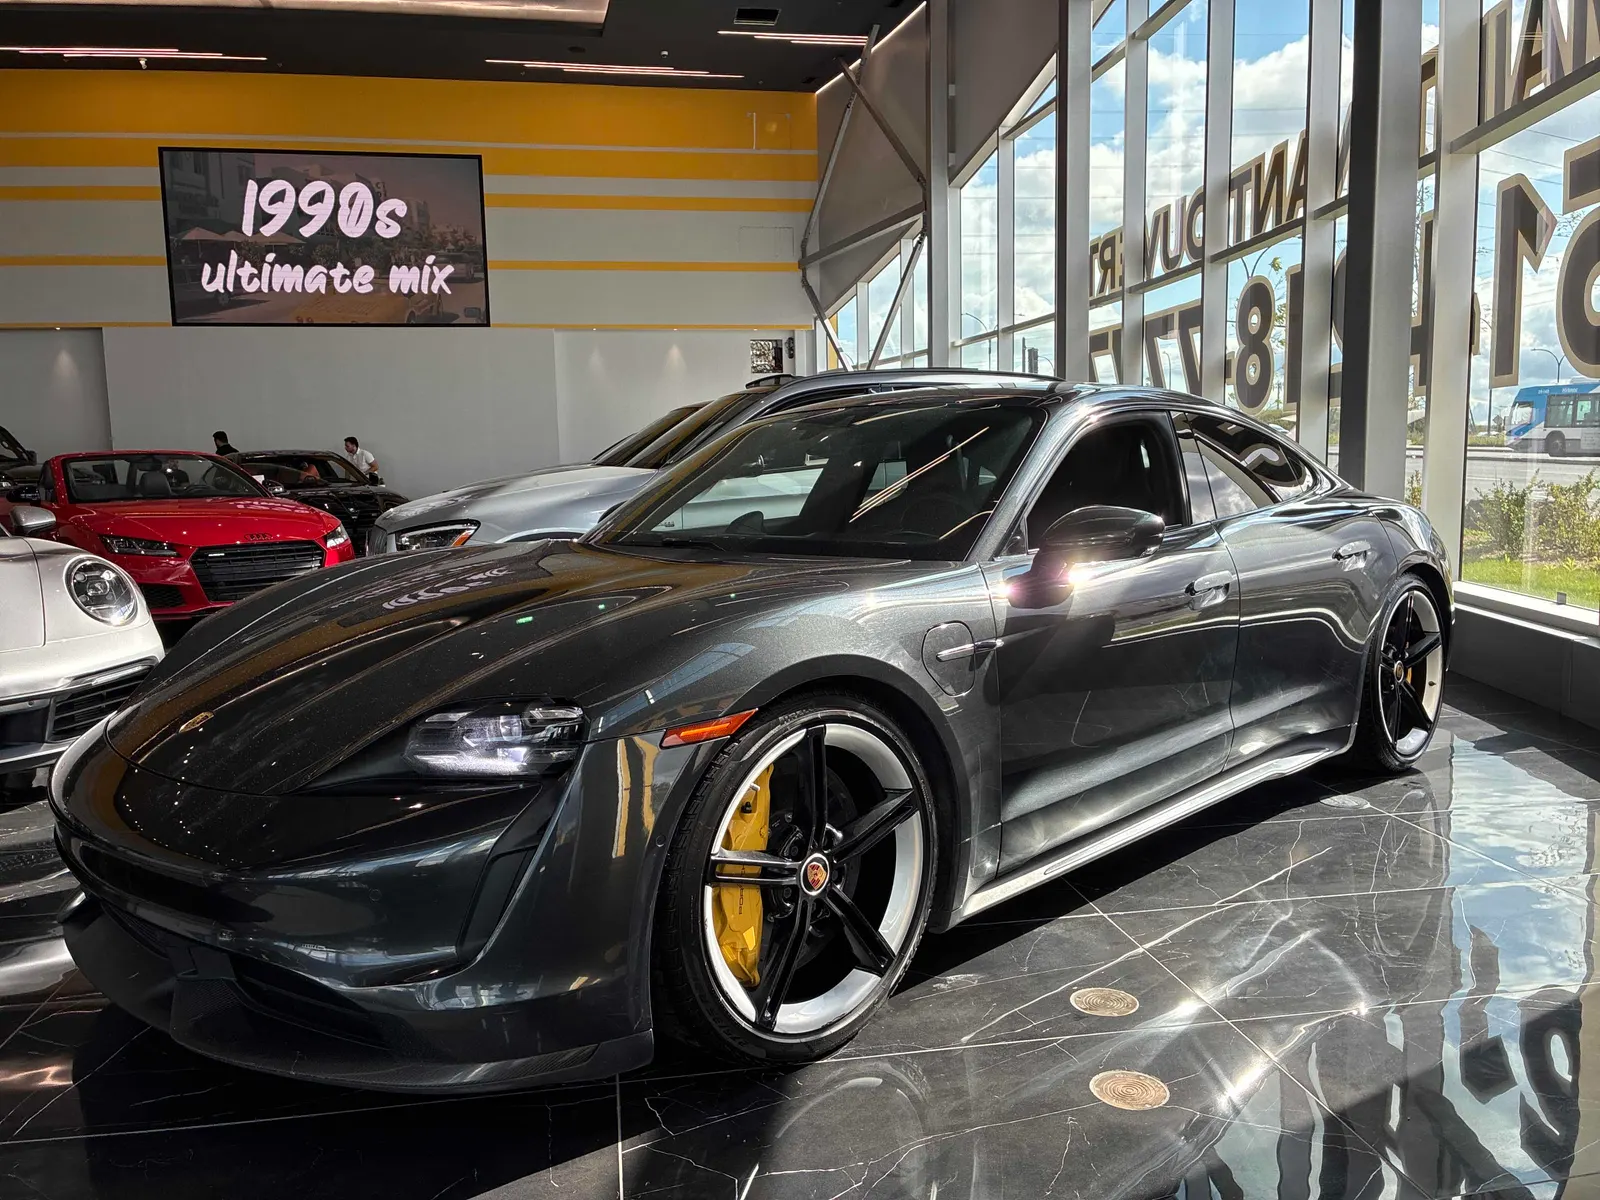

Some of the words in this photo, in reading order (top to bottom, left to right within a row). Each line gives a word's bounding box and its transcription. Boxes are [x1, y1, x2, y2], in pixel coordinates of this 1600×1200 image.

[242, 180, 407, 238] 1990s
[202, 250, 374, 294] ultimate
[389, 255, 454, 294] mix
